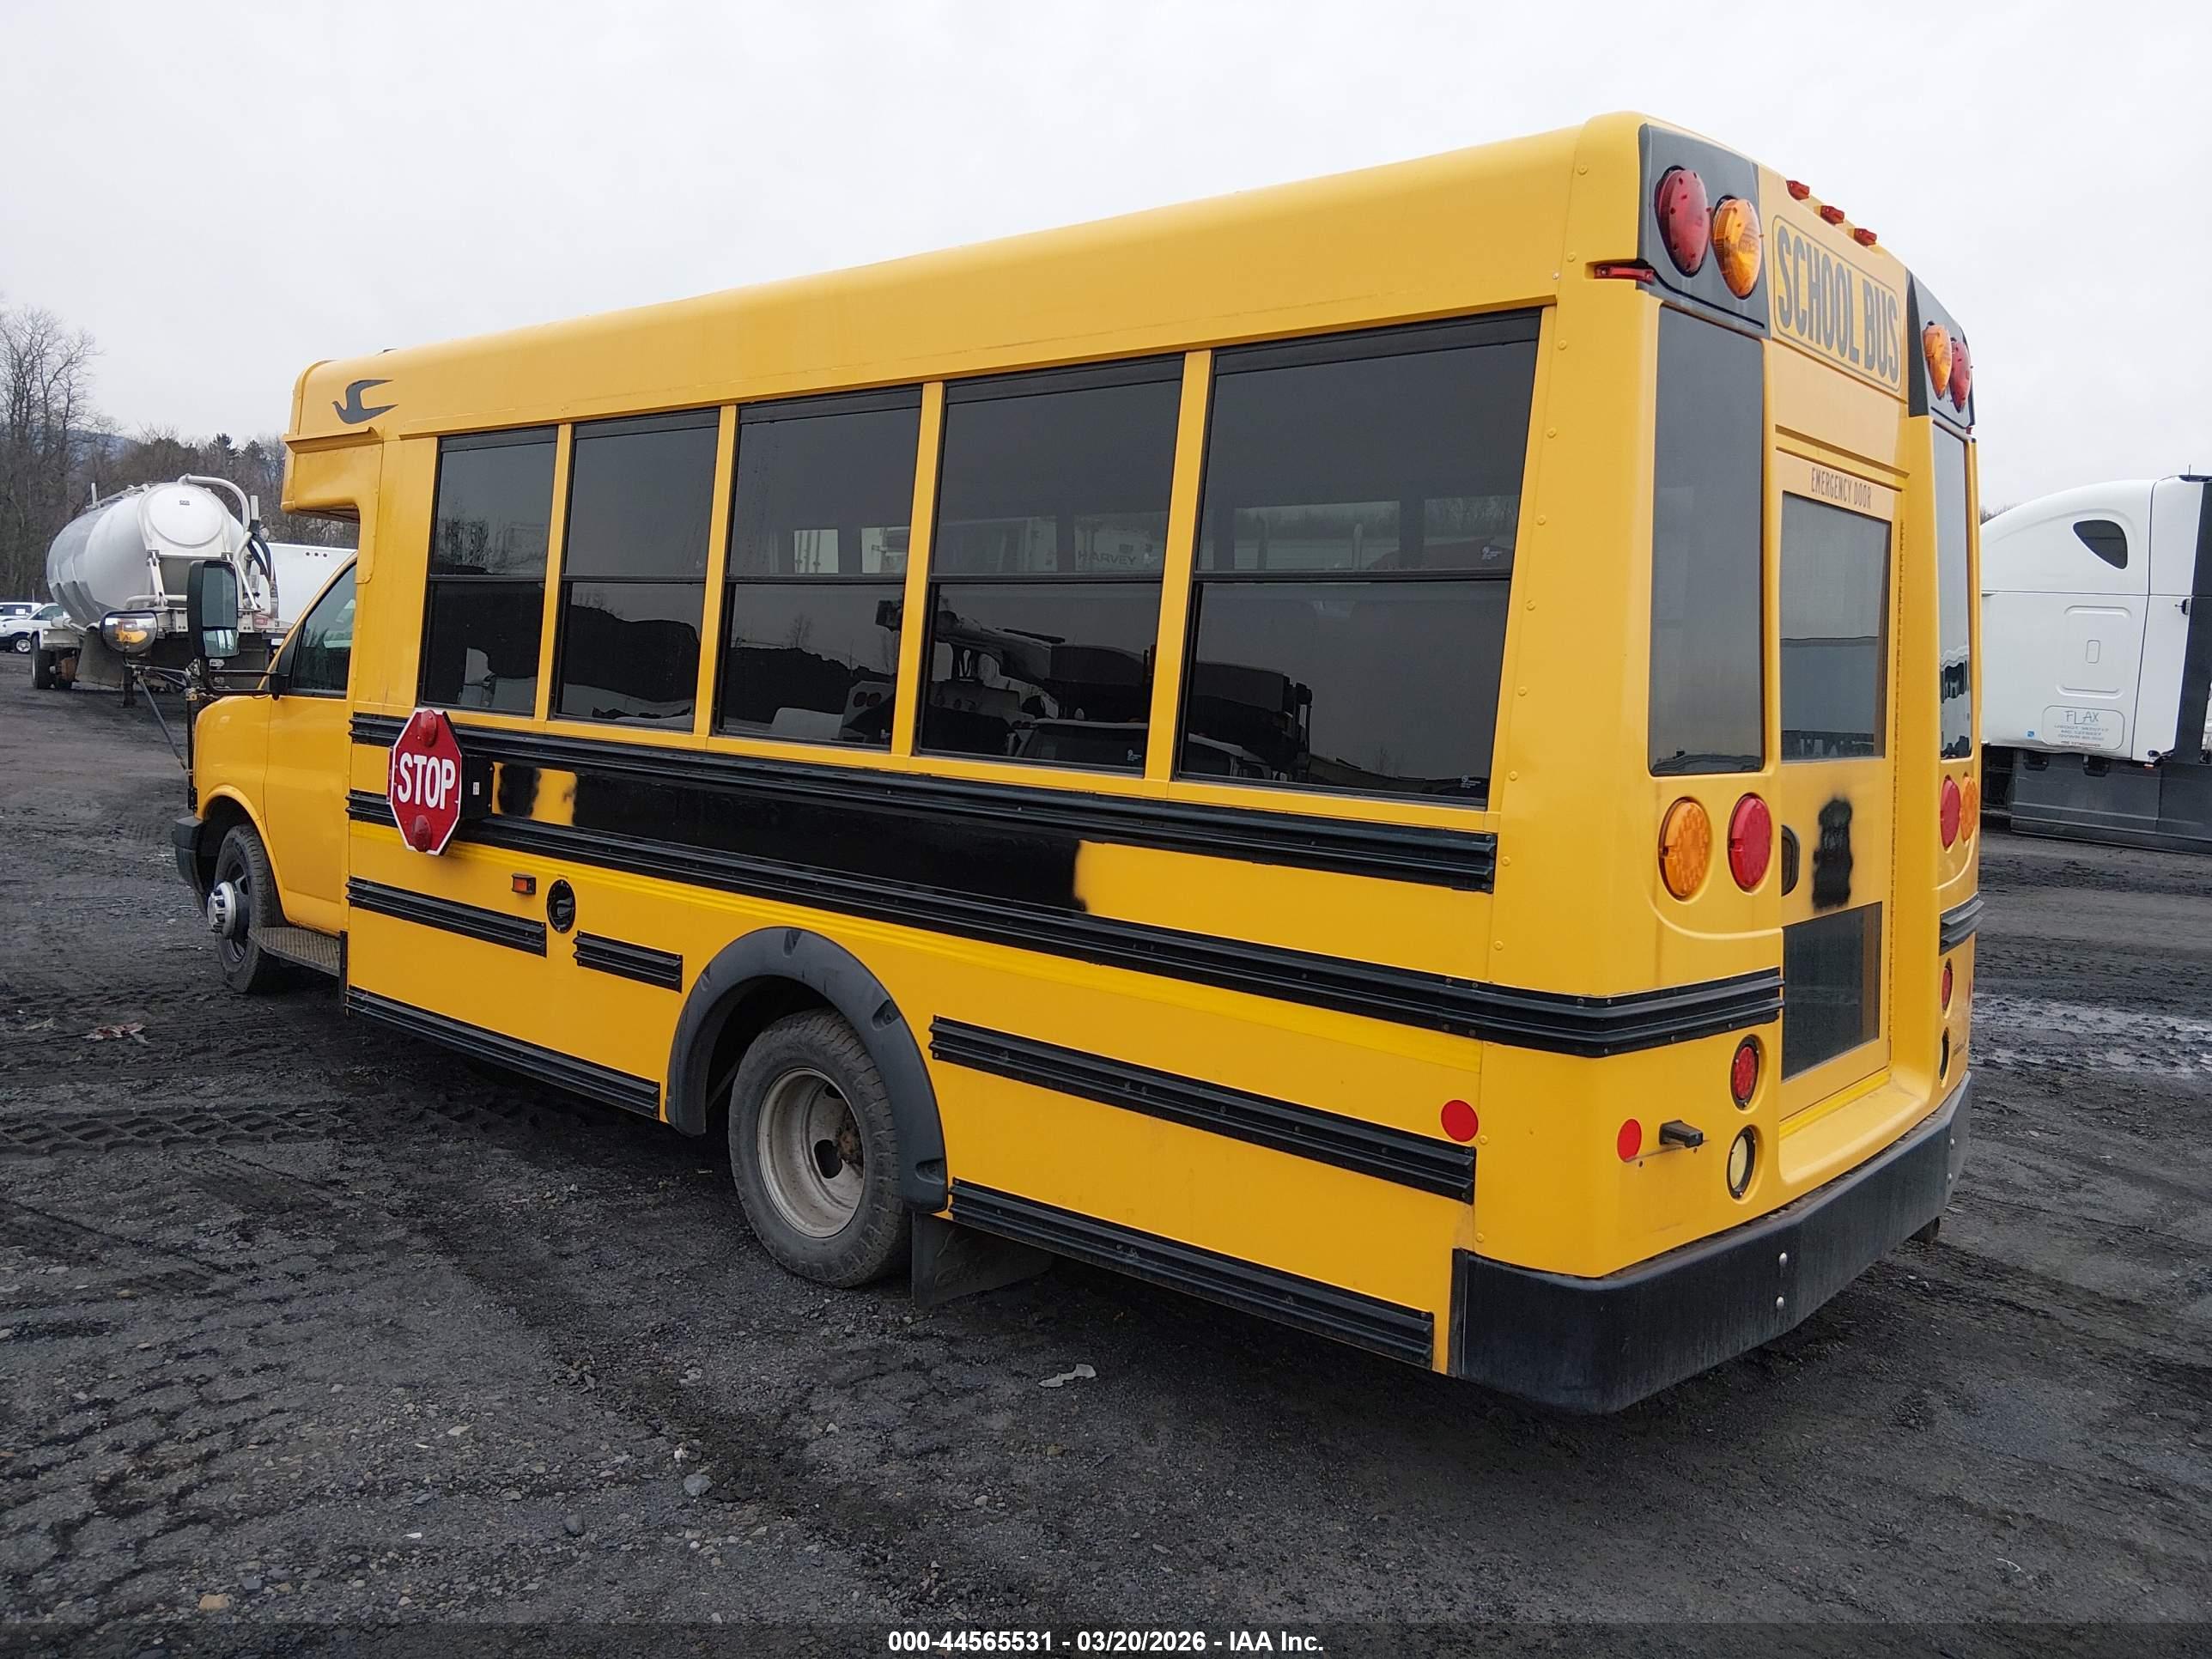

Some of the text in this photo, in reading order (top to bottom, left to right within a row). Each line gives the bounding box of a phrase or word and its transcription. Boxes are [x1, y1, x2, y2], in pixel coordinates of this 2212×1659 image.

[1778, 226, 1899, 383] SCHOOL BUS
[1811, 466, 1871, 509] EMERGENCY DOOR
[1079, 550, 1137, 566] HARVEY
[2064, 710, 2100, 725] FLAX
[397, 752, 456, 810] STOP
